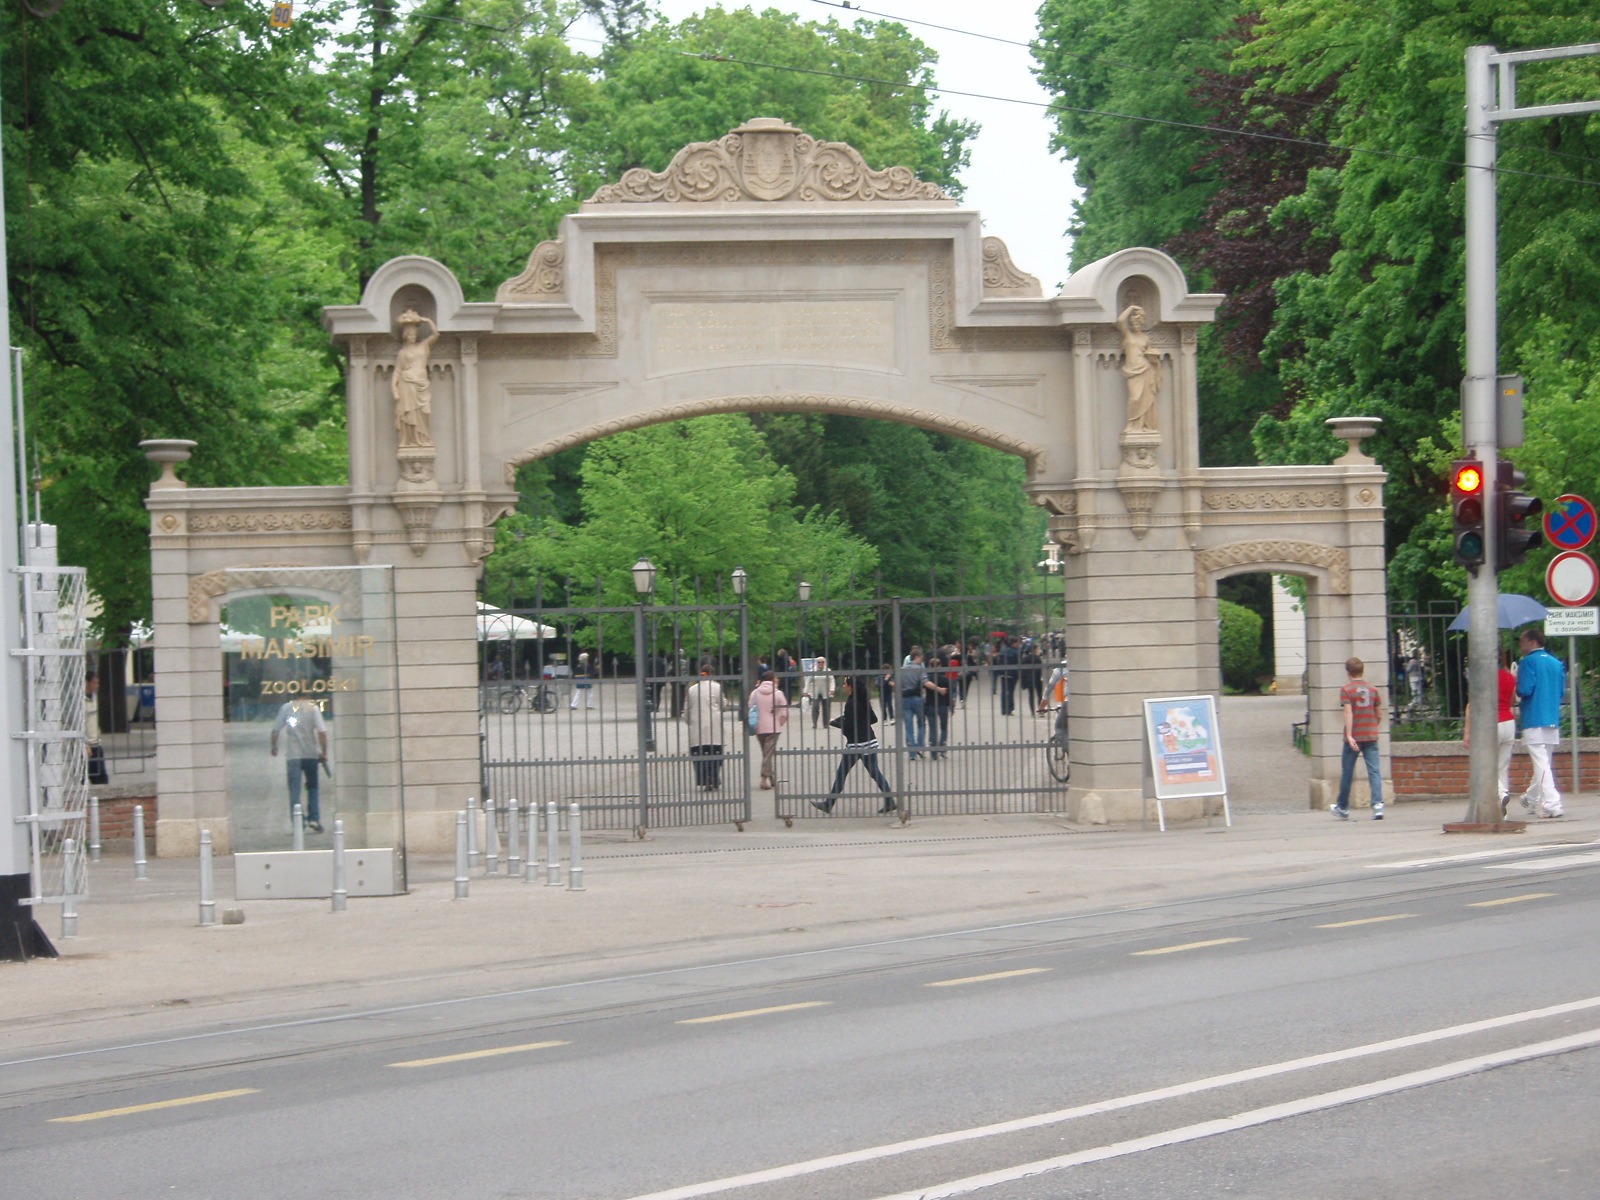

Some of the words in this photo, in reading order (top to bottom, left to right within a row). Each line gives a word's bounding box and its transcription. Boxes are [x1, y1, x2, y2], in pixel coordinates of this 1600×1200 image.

[274, 7, 290, 24] 90
[270, 605, 341, 628] PARK
[241, 636, 374, 660] MAKSIMIR
[262, 677, 357, 694] ZOOLOŠKI
[1356, 687, 1370, 708] 3
